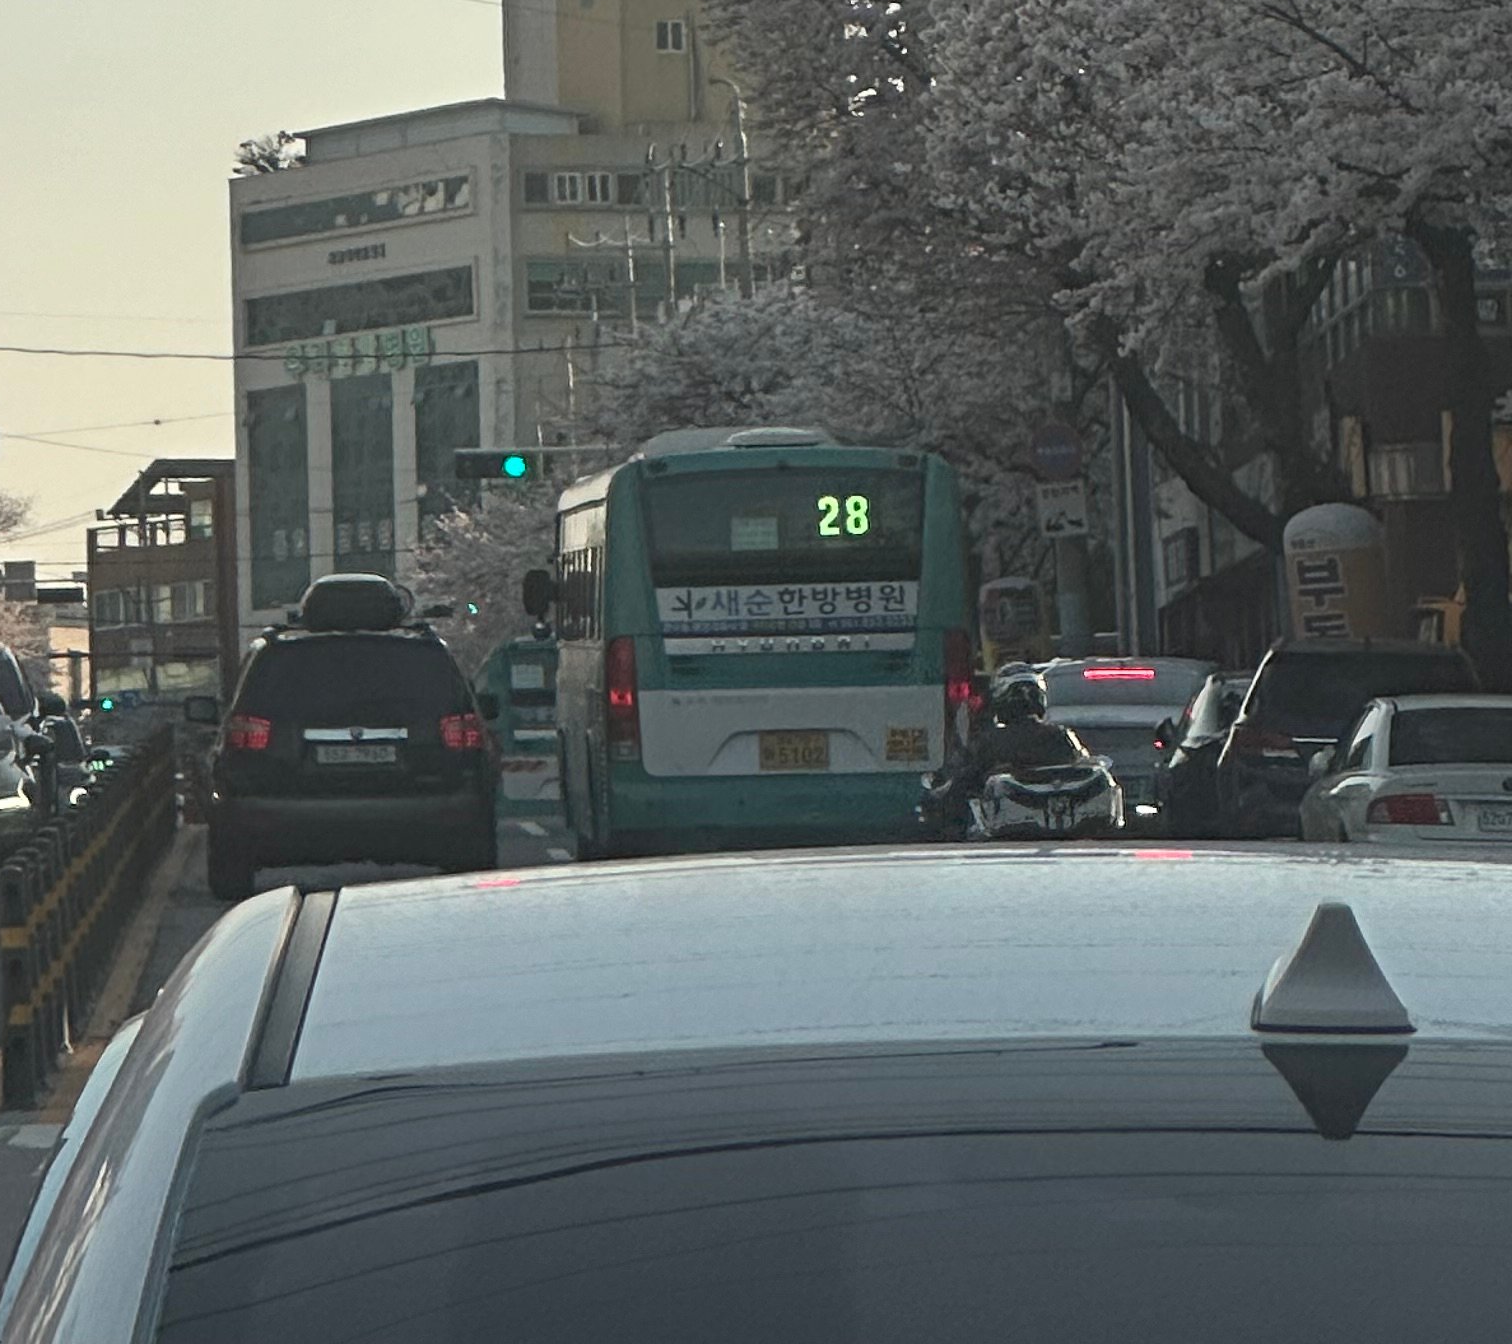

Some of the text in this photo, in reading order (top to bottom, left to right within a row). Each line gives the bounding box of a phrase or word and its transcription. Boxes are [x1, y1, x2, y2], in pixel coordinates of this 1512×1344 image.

[817, 495, 869, 536] 28
[710, 584, 906, 617] 새순한방병원
[711, 635, 871, 653] HYUNDAI
